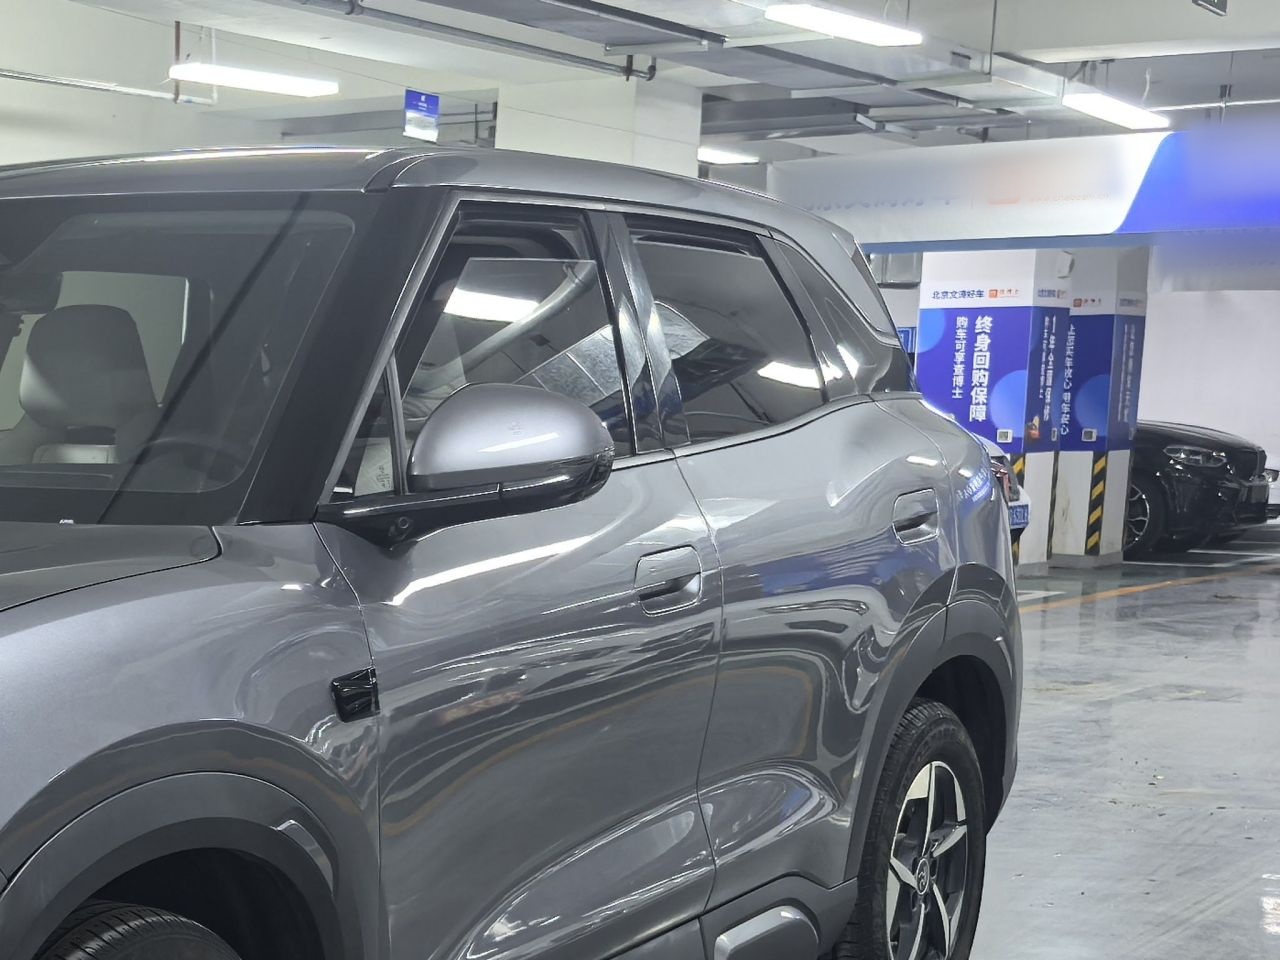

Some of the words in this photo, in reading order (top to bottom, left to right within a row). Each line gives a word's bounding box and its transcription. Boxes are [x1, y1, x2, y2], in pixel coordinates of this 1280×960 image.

[969, 315, 993, 422] 终身回购保障
